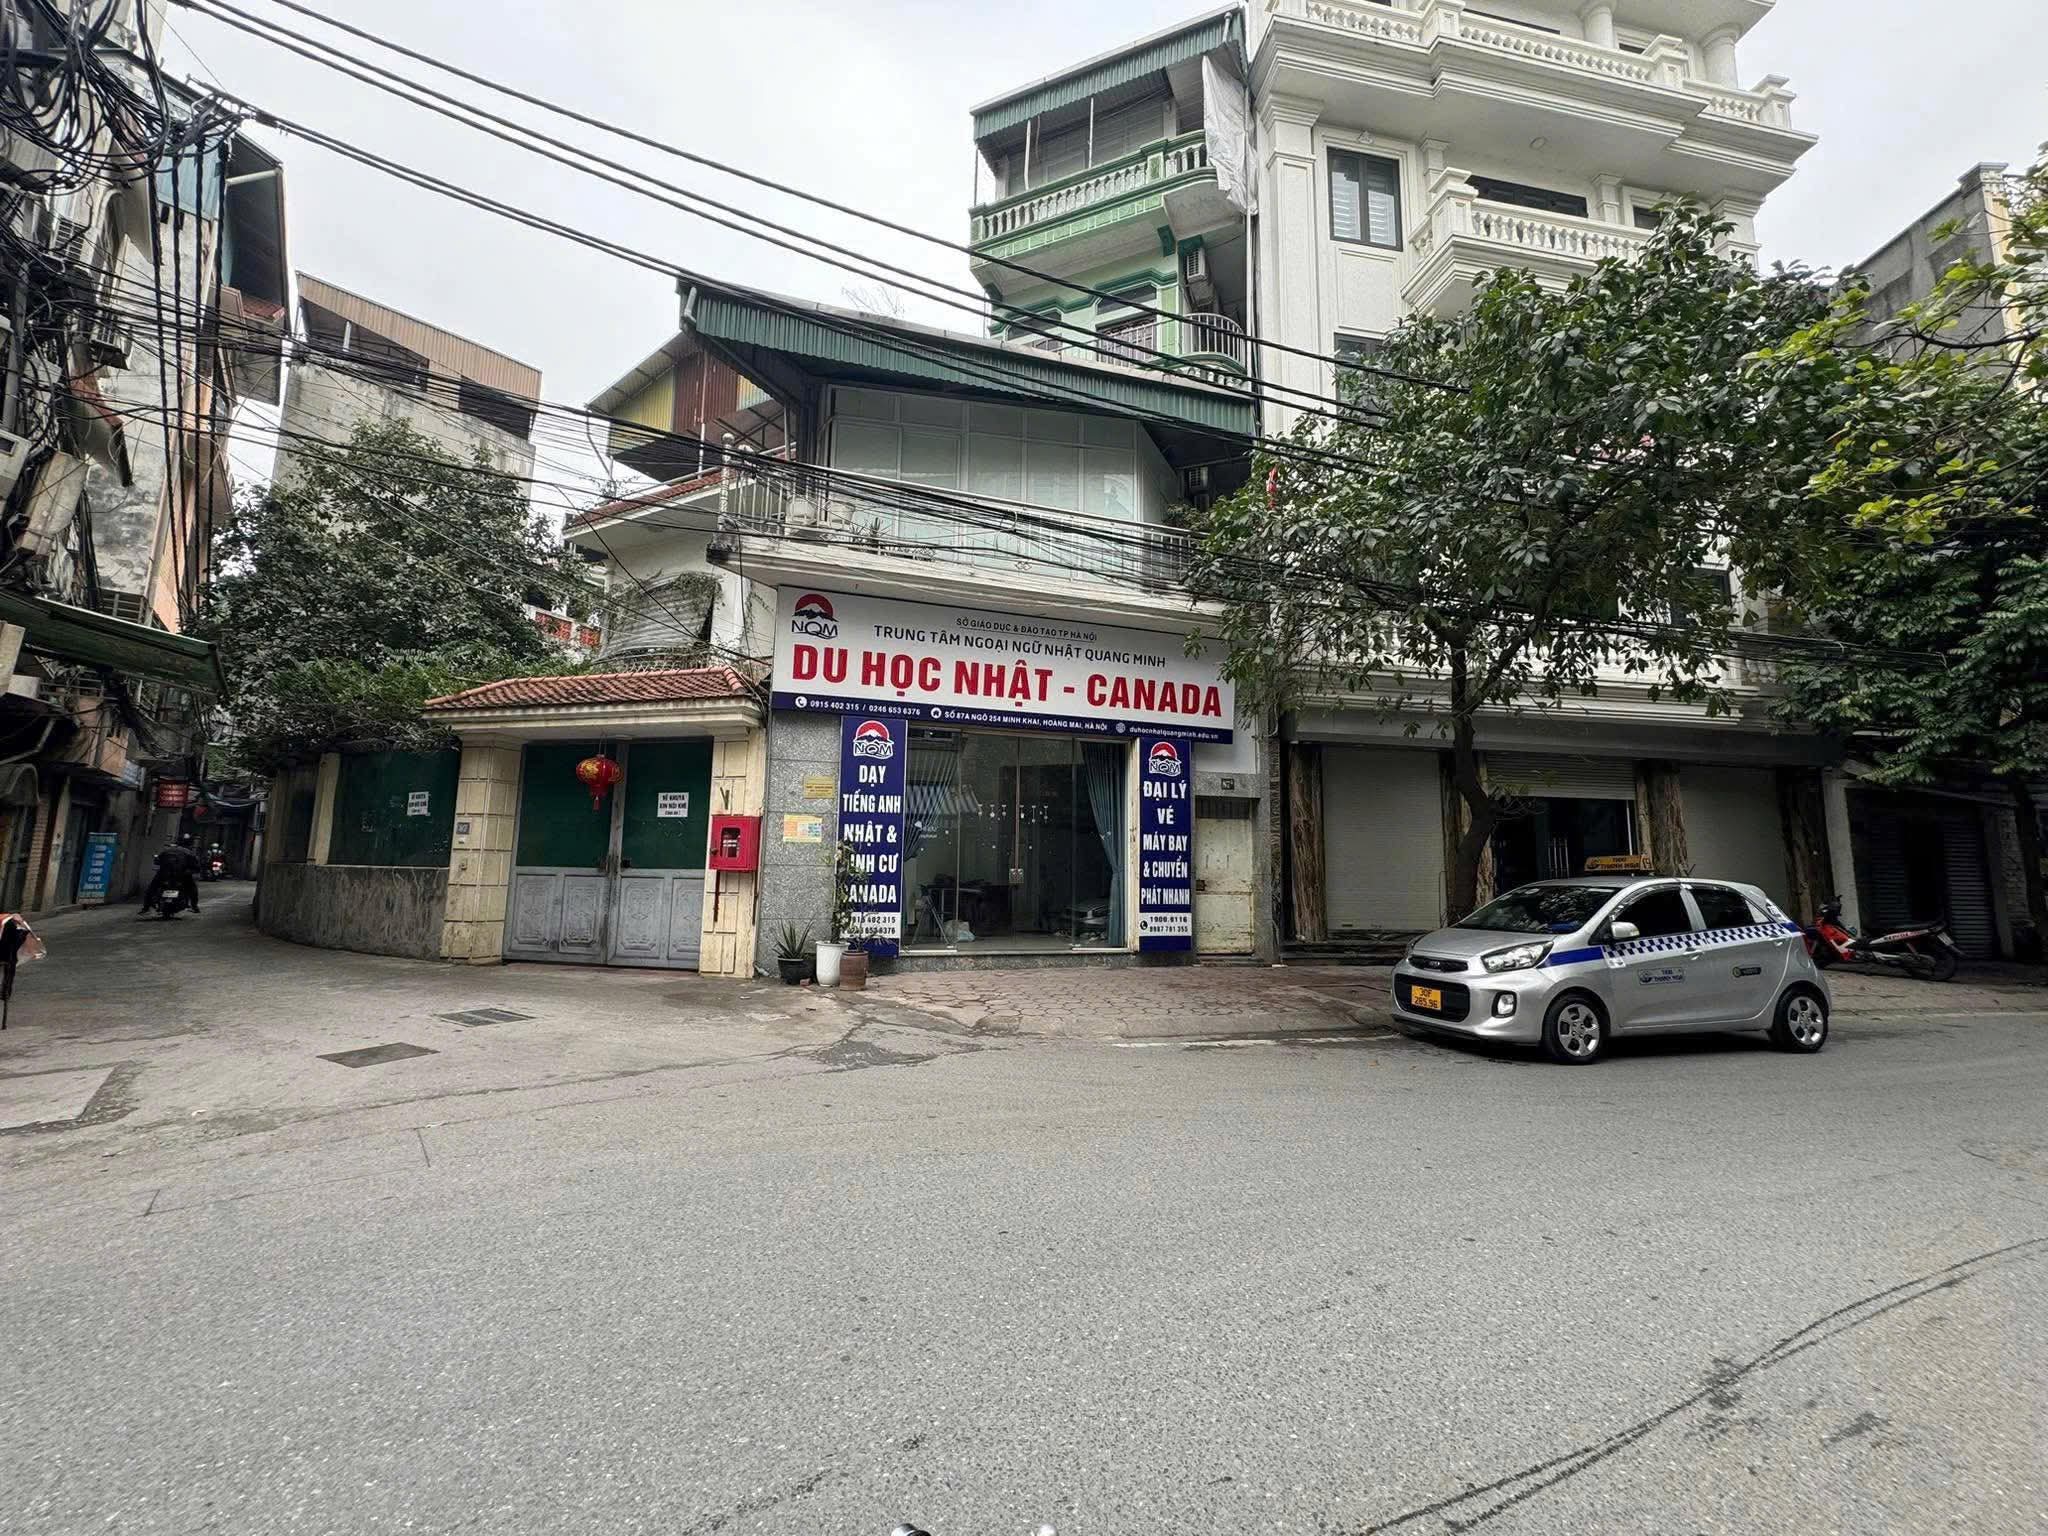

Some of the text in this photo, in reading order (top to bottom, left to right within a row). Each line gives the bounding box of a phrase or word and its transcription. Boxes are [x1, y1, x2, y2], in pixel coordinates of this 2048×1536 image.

[792, 620, 838, 638] NQM
[1013, 624, 1019, 632] &
[874, 625, 1166, 668] TRUNG TÂM NGOẠI NGỮ NHẬT QUANG MINH
[792, 644, 848, 683] DU
[861, 650, 941, 697] HỌC
[954, 659, 1053, 707] NHẬT
[1087, 673, 1222, 717] CANADA
[810, 699, 829, 709] 0915
[830, 701, 844, 710] 402
[846, 703, 860, 711] 315
[1002, 715, 1021, 723] MINH
[858, 765, 886, 787] DẠY
[843, 789, 876, 813] TIẾNG
[878, 795, 901, 813] ANH
[1143, 780, 1187, 801] ĐẠI LÝ
[1157, 805, 1174, 825] VÉ
[843, 821, 883, 847] NHẬT
[887, 825, 897, 843] &
[1143, 831, 1188, 851] MÁY BAY
[849, 853, 899, 876] ỊNH CƯ
[1143, 855, 1188, 878] & CHUYỂN
[845, 884, 896, 903] ANADA
[1141, 884, 1190, 905] PHÁT NHANH
[883, 916, 896, 924] 315
